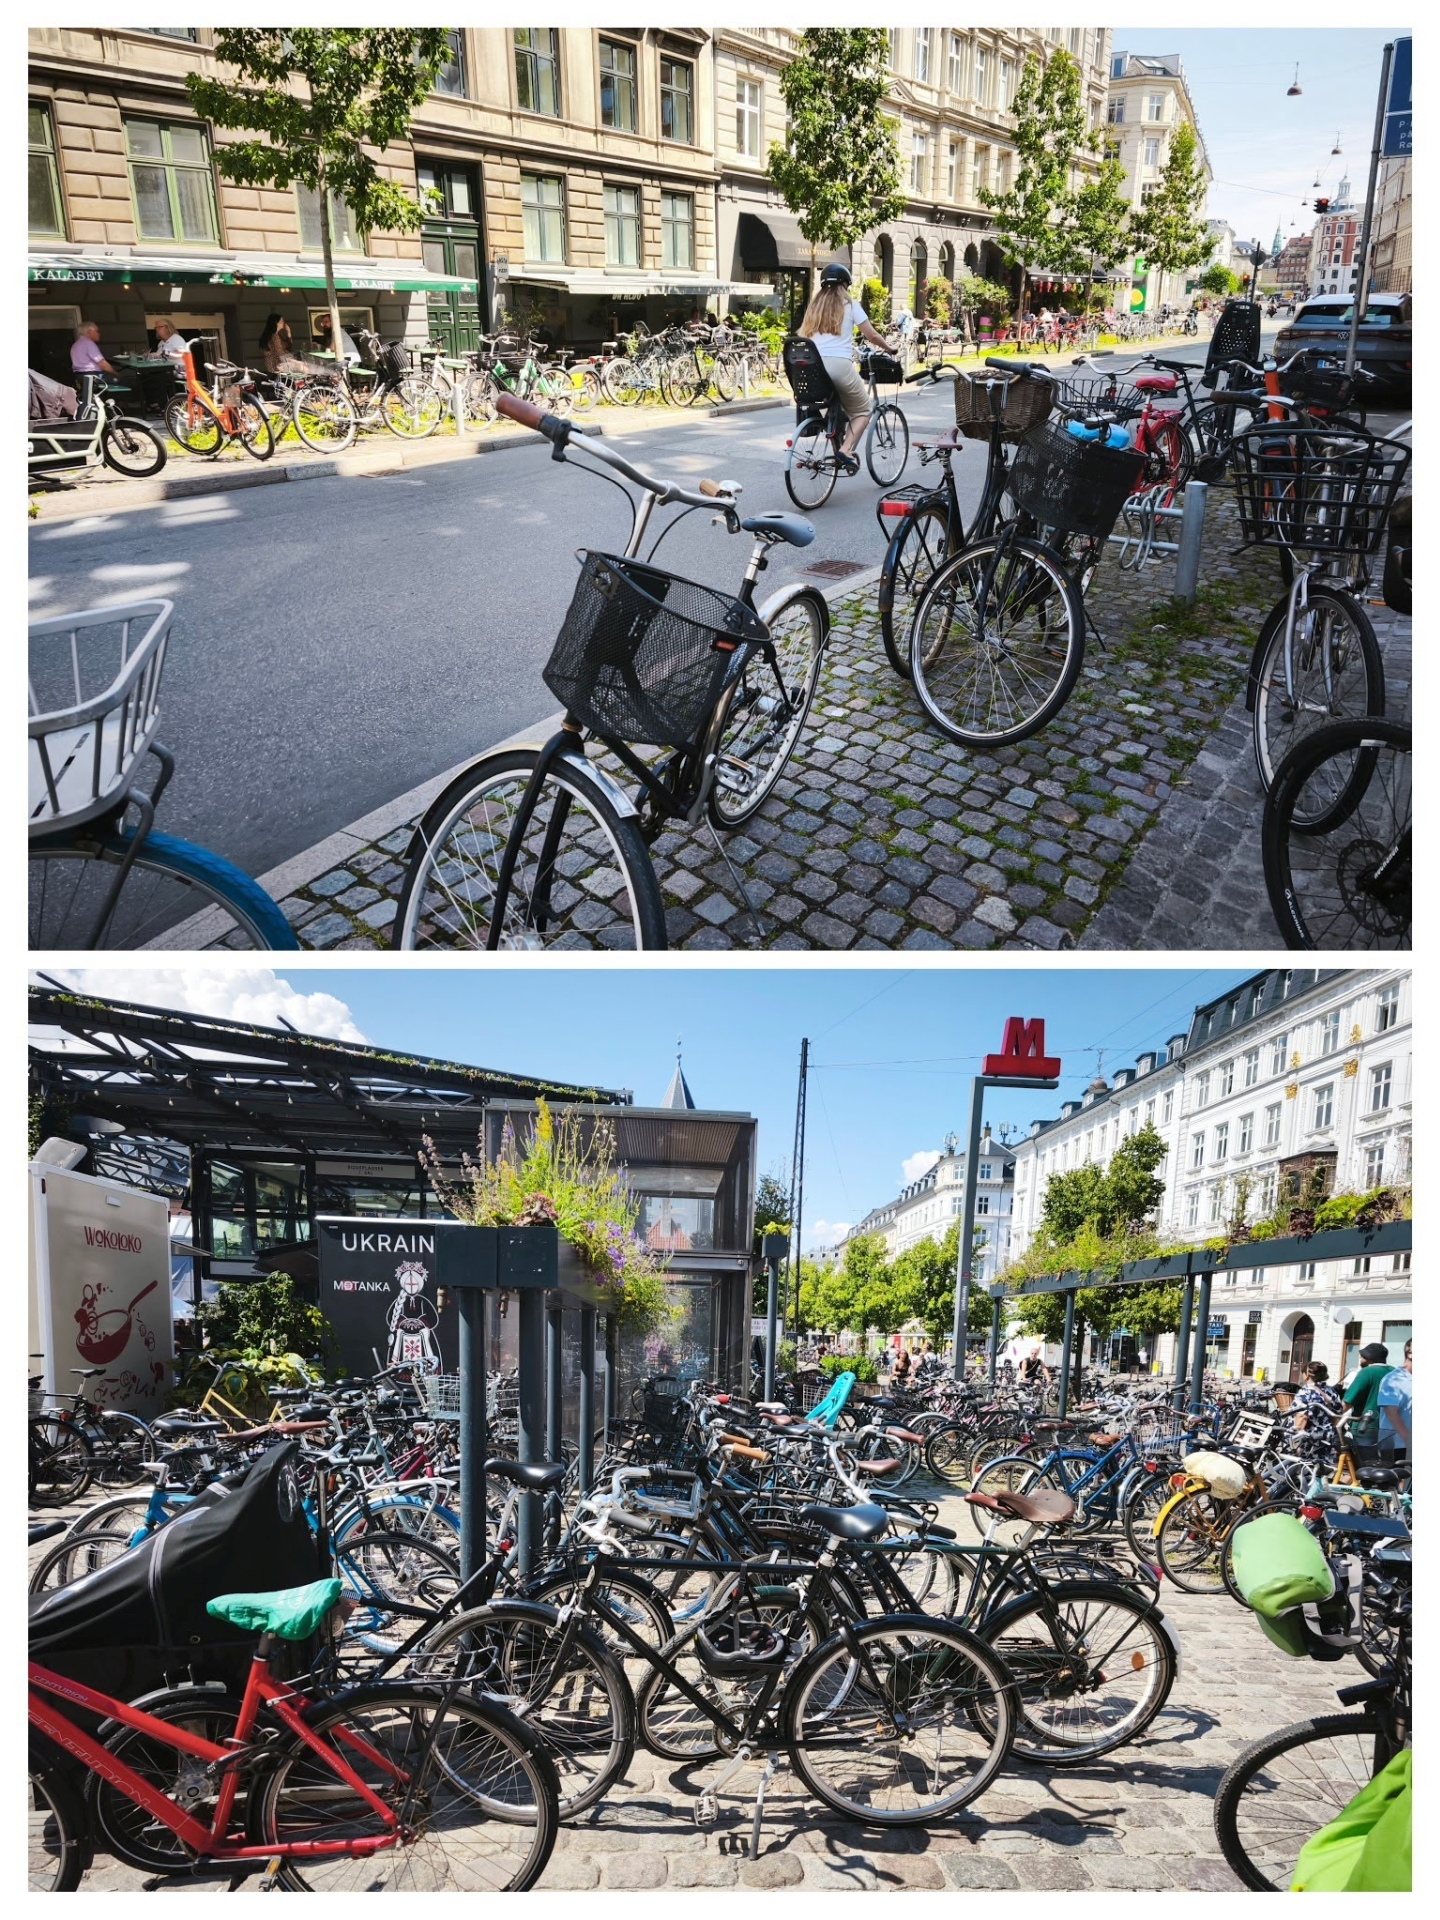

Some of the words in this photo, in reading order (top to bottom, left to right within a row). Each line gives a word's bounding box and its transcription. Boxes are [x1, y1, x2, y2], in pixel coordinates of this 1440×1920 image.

[33, 269, 104, 281] KALASET
[350, 279, 395, 290] KALASET
[84, 1225, 142, 1253] WOKOLOKO
[342, 1233, 434, 1254] UKRAIN
[333, 1280, 391, 1292] MOTANKA
[33, 1674, 88, 1702] CENTURION
